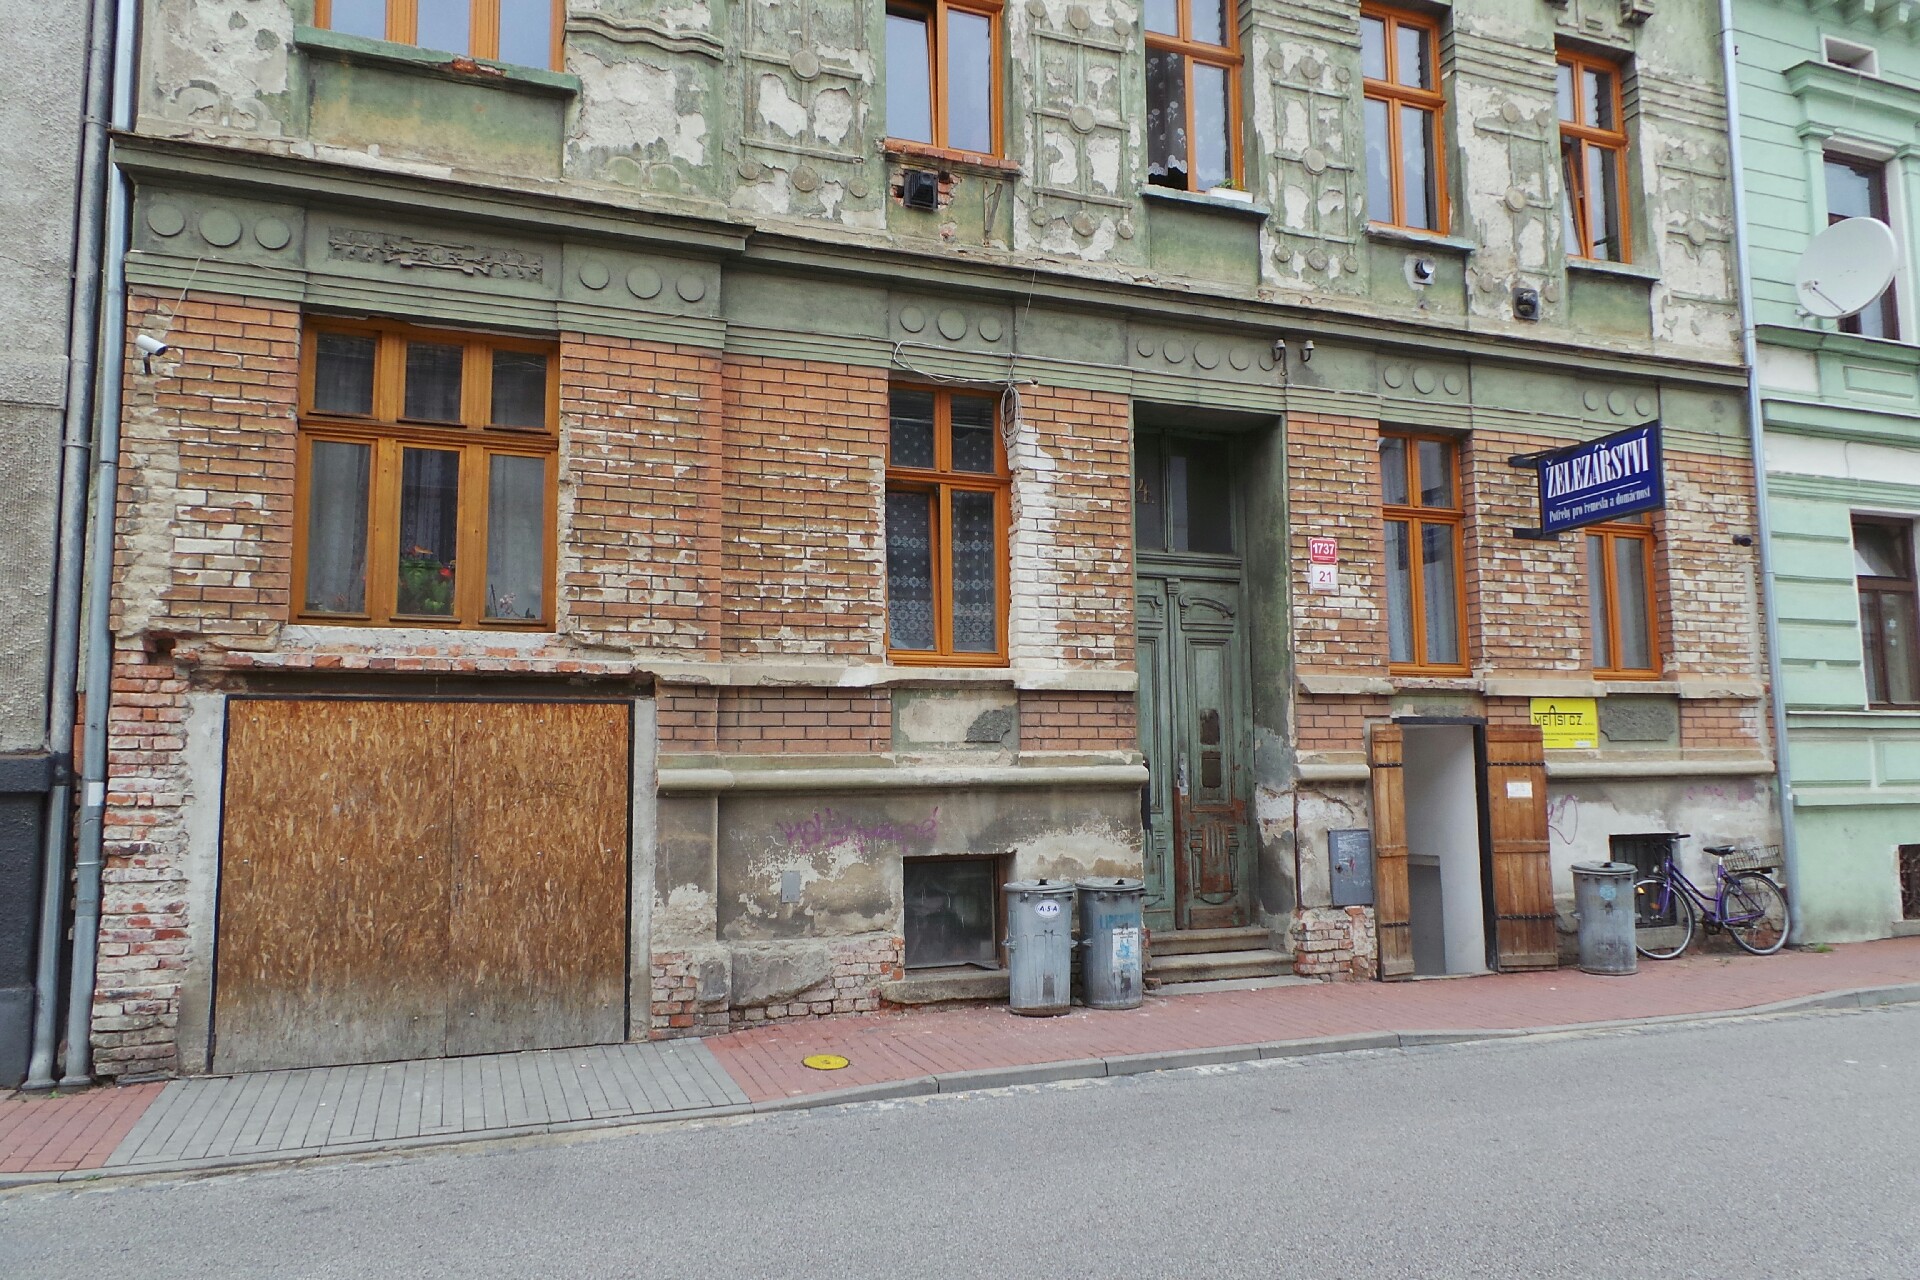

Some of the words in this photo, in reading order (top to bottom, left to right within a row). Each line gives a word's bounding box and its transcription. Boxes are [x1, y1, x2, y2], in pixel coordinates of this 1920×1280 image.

[1545, 429, 1649, 498] ŽELEZÁŘSTVÍ
[1549, 507, 1570, 523] Potřeby
[1572, 505, 1583, 519] pro
[1583, 496, 1608, 513] řemesla
[1609, 497, 1615, 507] a
[1615, 484, 1651, 506] domácnost
[1313, 543, 1335, 555] 1737
[1319, 570, 1332, 583] 21
